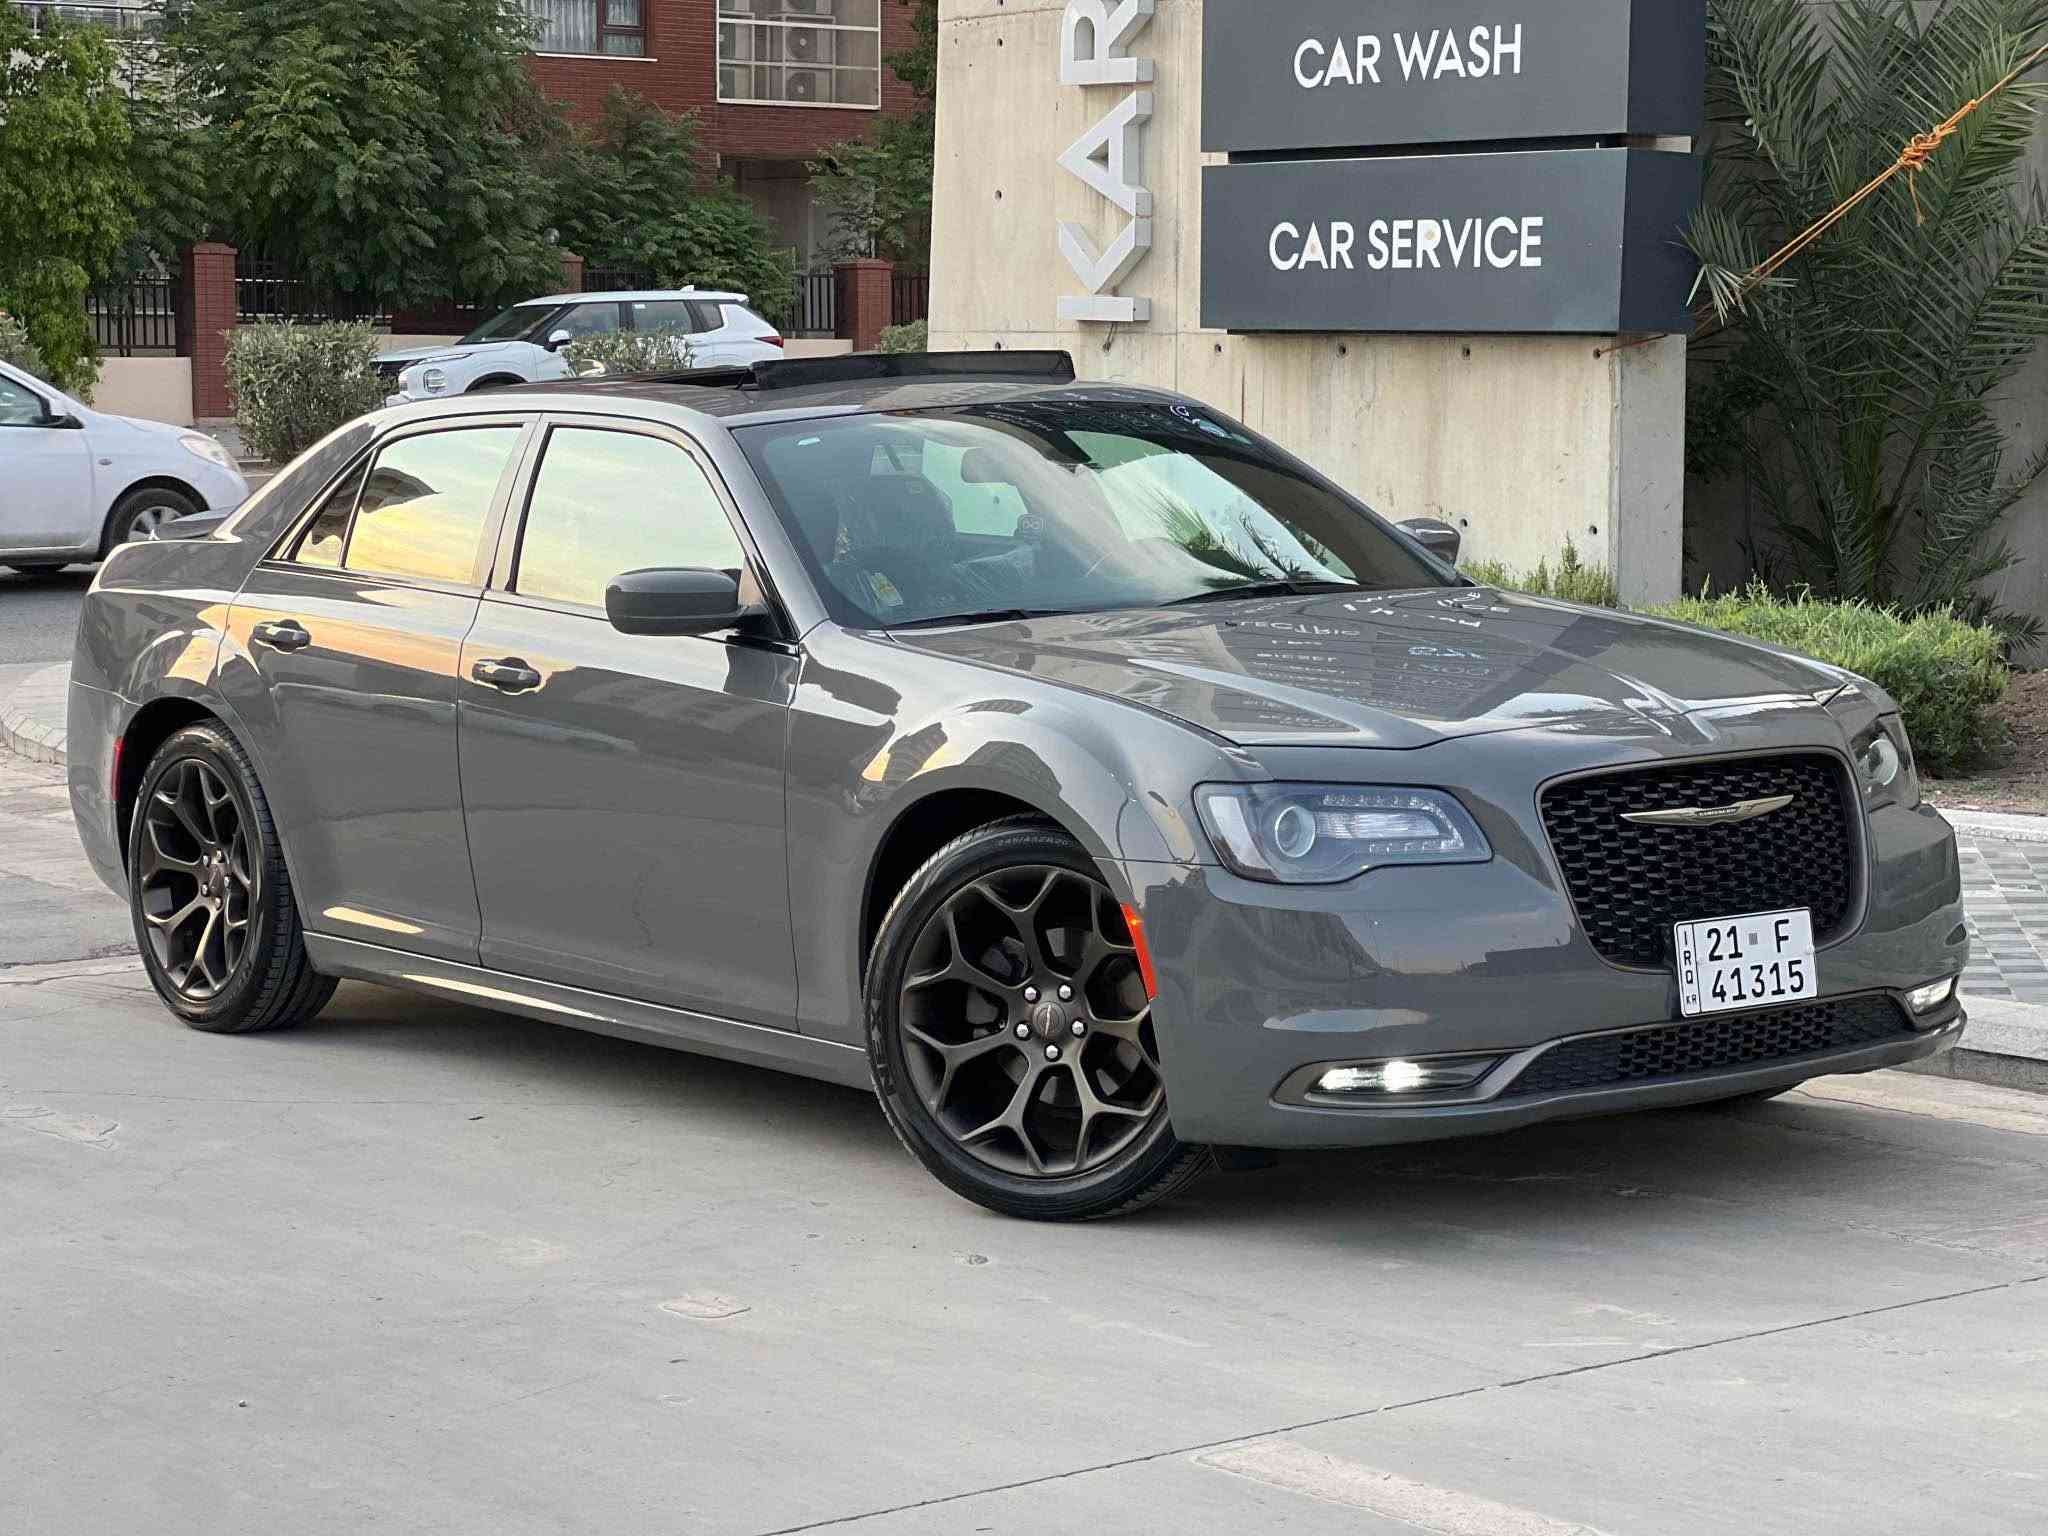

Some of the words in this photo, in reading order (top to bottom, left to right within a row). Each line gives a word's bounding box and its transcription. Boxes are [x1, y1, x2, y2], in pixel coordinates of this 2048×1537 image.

[1293, 35, 1381, 88] CAR
[1392, 23, 1522, 82] WASH
[1056, 0, 1153, 323] KAR
[1268, 220, 1355, 270] CAR
[1366, 216, 1545, 270] SERVICE
[1706, 925, 1743, 961] 21
[1774, 918, 1789, 953] F
[1711, 959, 1804, 1003] 41315
